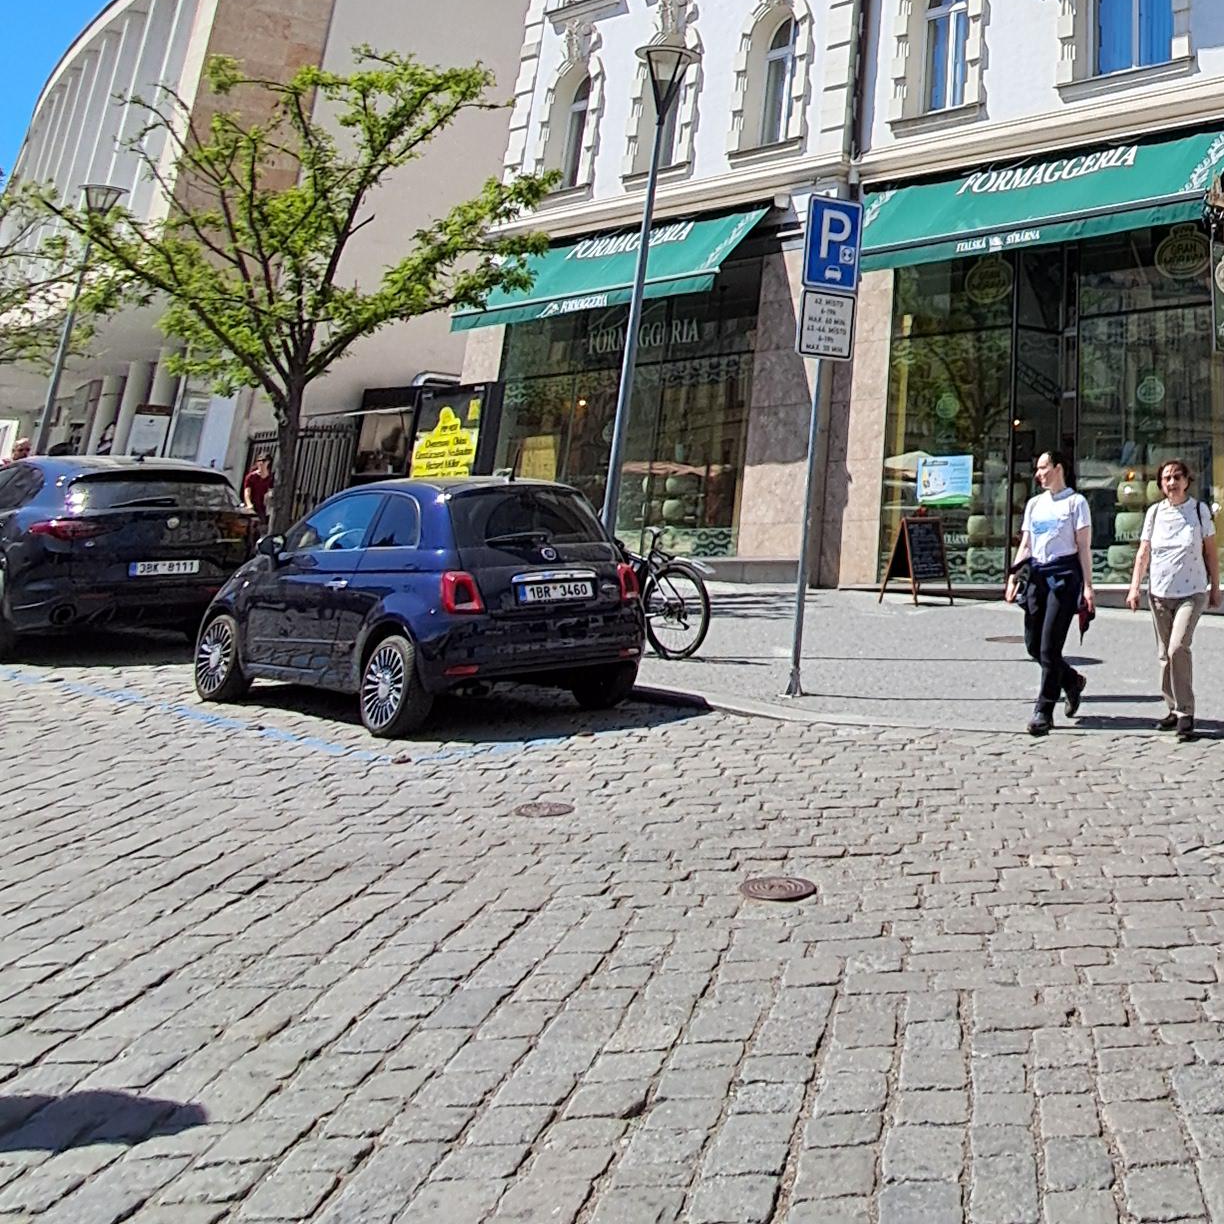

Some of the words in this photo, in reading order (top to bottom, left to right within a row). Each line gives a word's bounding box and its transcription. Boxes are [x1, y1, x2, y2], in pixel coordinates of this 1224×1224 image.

[956, 145, 1139, 196] FORMAGGERIA
[820, 209, 852, 258] P
[529, 585, 552, 599] 1BR
[559, 583, 588, 597] 3460
